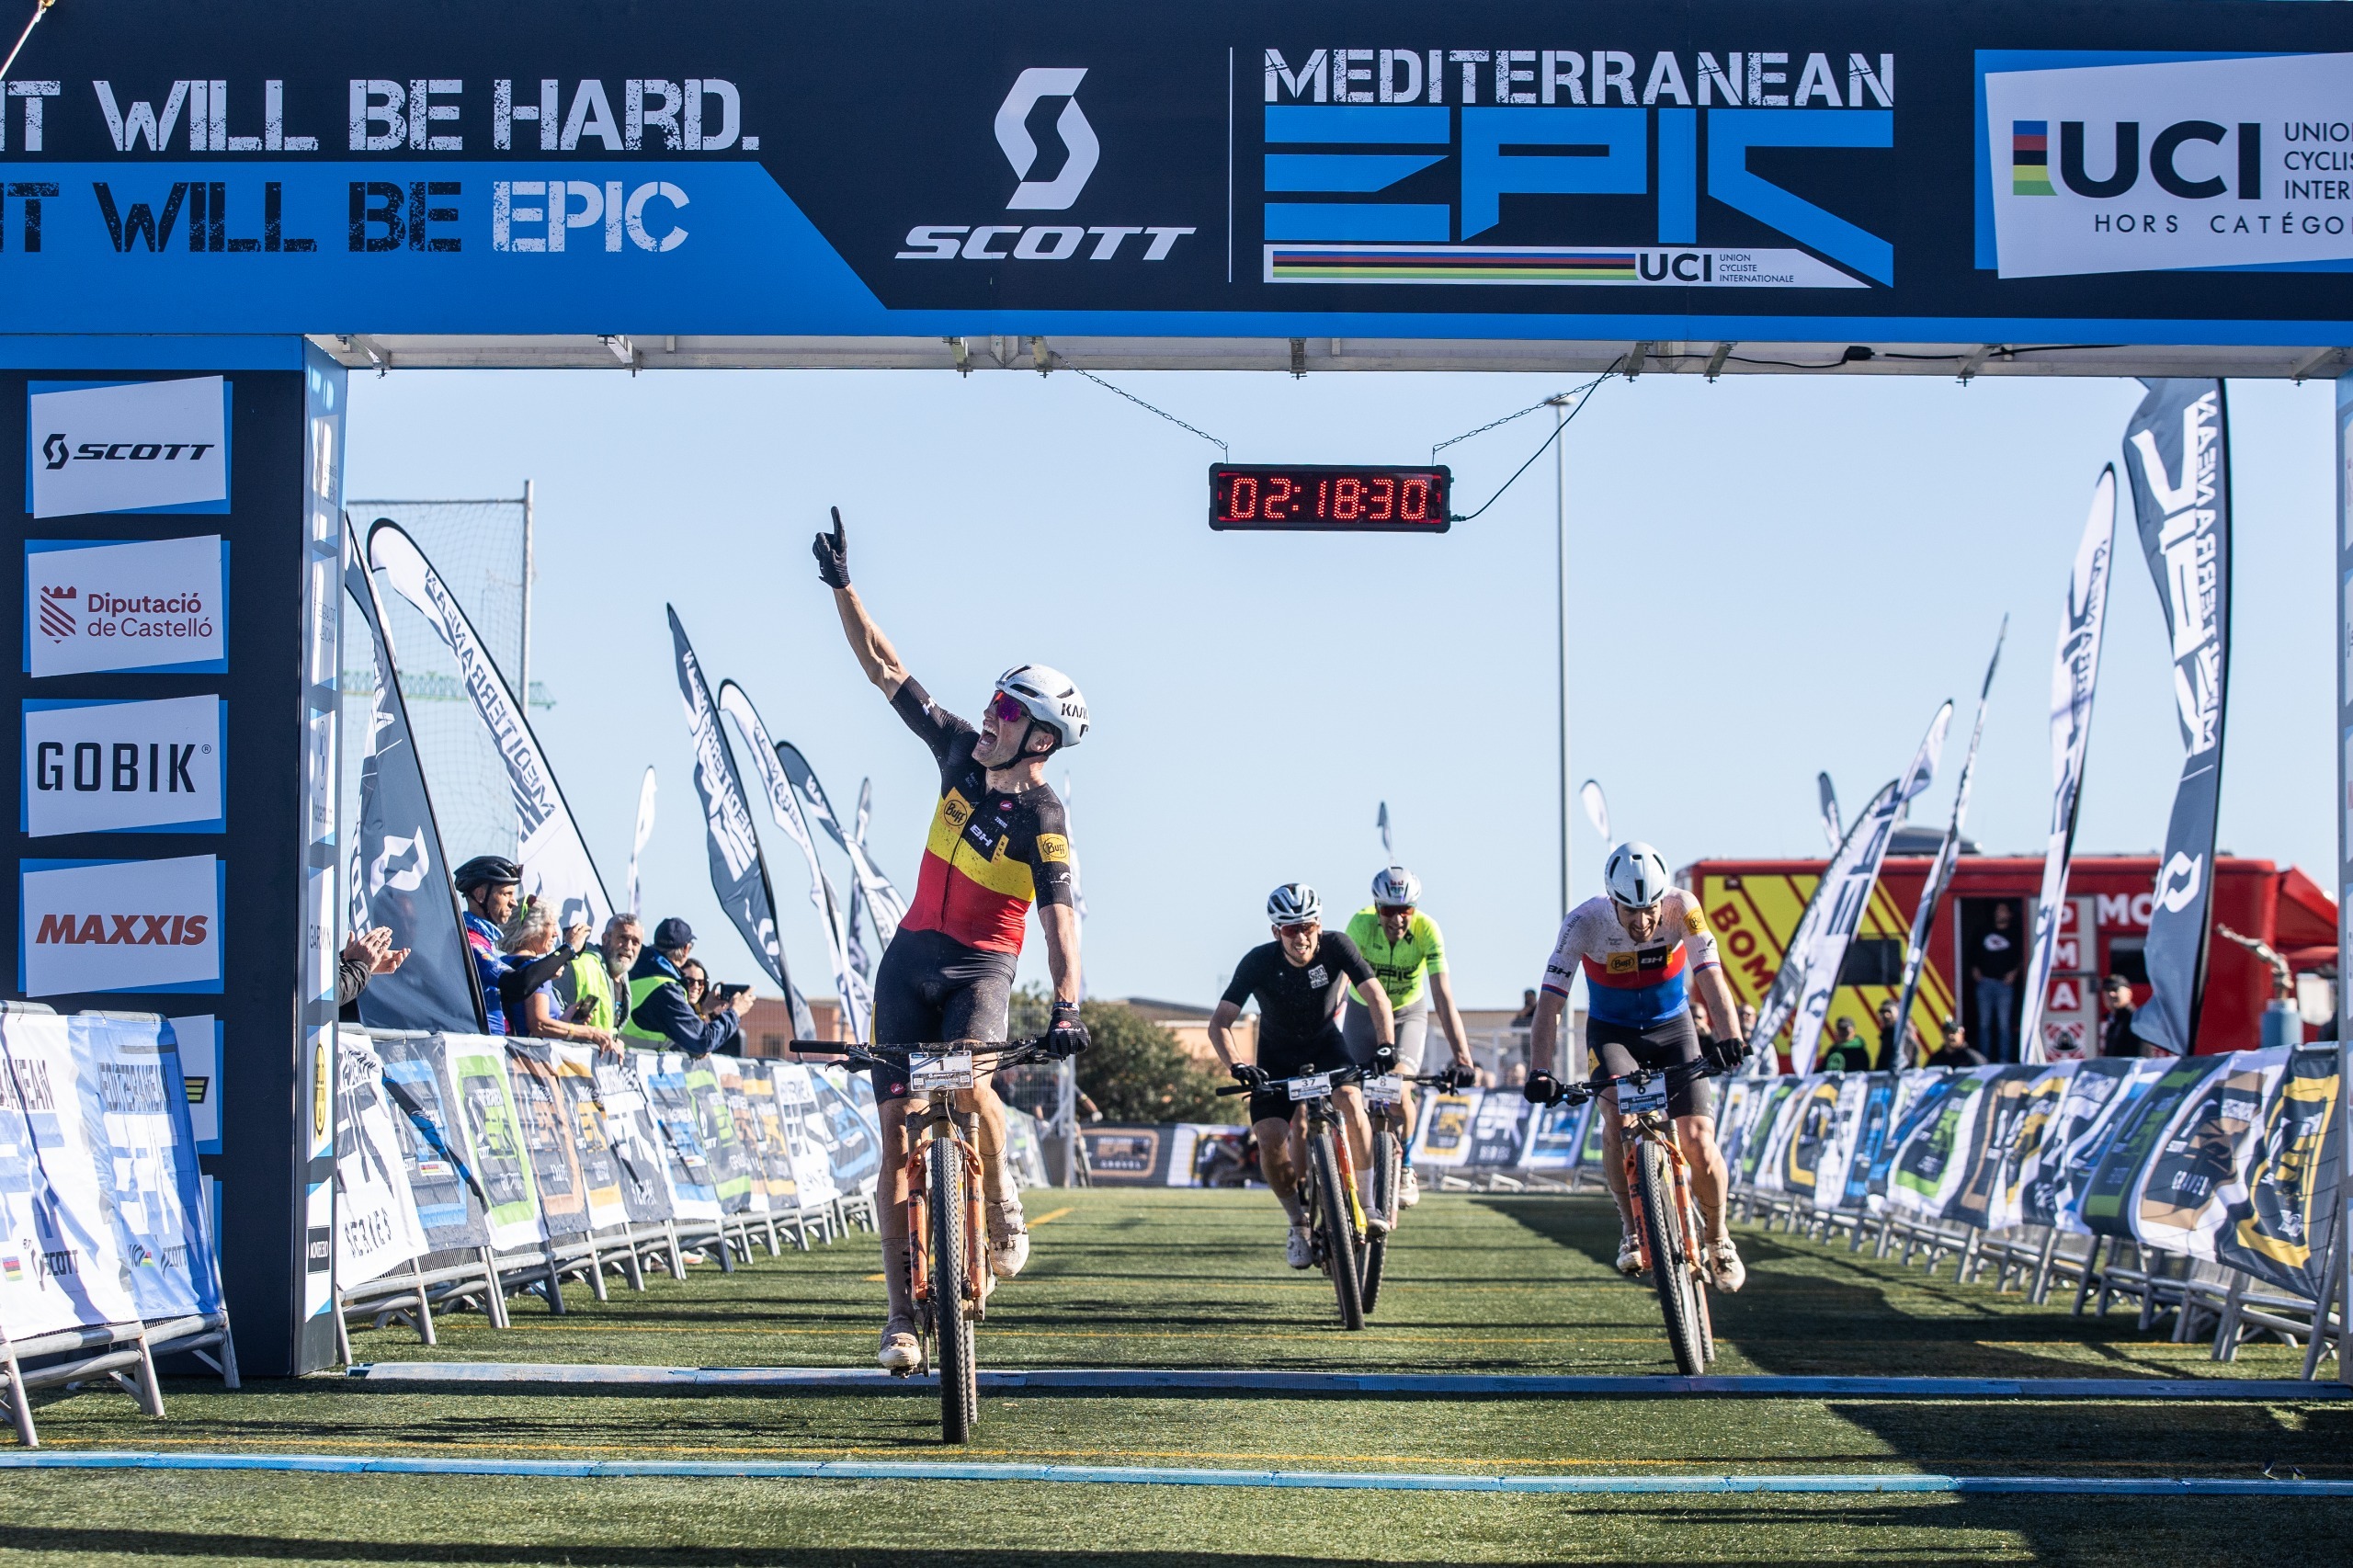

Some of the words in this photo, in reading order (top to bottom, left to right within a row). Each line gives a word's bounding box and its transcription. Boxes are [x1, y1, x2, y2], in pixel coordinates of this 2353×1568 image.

[1264, 48, 1894, 108] MEDITERRANEAN
[92, 80, 319, 152] WILL
[348, 80, 463, 152] BE
[493, 79, 760, 152] HARD.
[2285, 122, 2353, 142] UNIO
[2060, 119, 2261, 200] UCI
[1264, 105, 1894, 288] EPIC
[2285, 180, 2353, 199] INTER
[0, 182, 60, 253] T
[92, 182, 318, 253] WILL
[349, 182, 462, 253] BE
[493, 181, 690, 253] EPIC
[2095, 213, 2179, 233] HORS
[2210, 211, 2353, 235] CATÉGO
[894, 225, 1197, 260] SCOTT
[1639, 253, 1712, 282] UCI
[1719, 254, 1751, 262] UNION
[1719, 264, 1757, 273] CYCLISTE
[1719, 274, 1794, 283] INTERNATIONALE
[73, 443, 215, 460] SCOTT
[1230, 477, 1427, 519] 02:18:30
[87, 592, 202, 617] Diputació
[87, 618, 117, 637] de
[120, 617, 213, 638] Castelló
[970, 824, 994, 847] BH
[994, 841, 1006, 861] TEAM
[35, 914, 210, 946] MAXXIS
[310, 924, 332, 950] GARMIN
[1640, 956, 1664, 964] BH
[1710, 901, 1779, 1002] BOM
[1546, 964, 1573, 979] BH
[1302, 1078, 1315, 1087] 37
[1380, 1078, 1387, 1086] 8
[1637, 1085, 1646, 1095] 6
